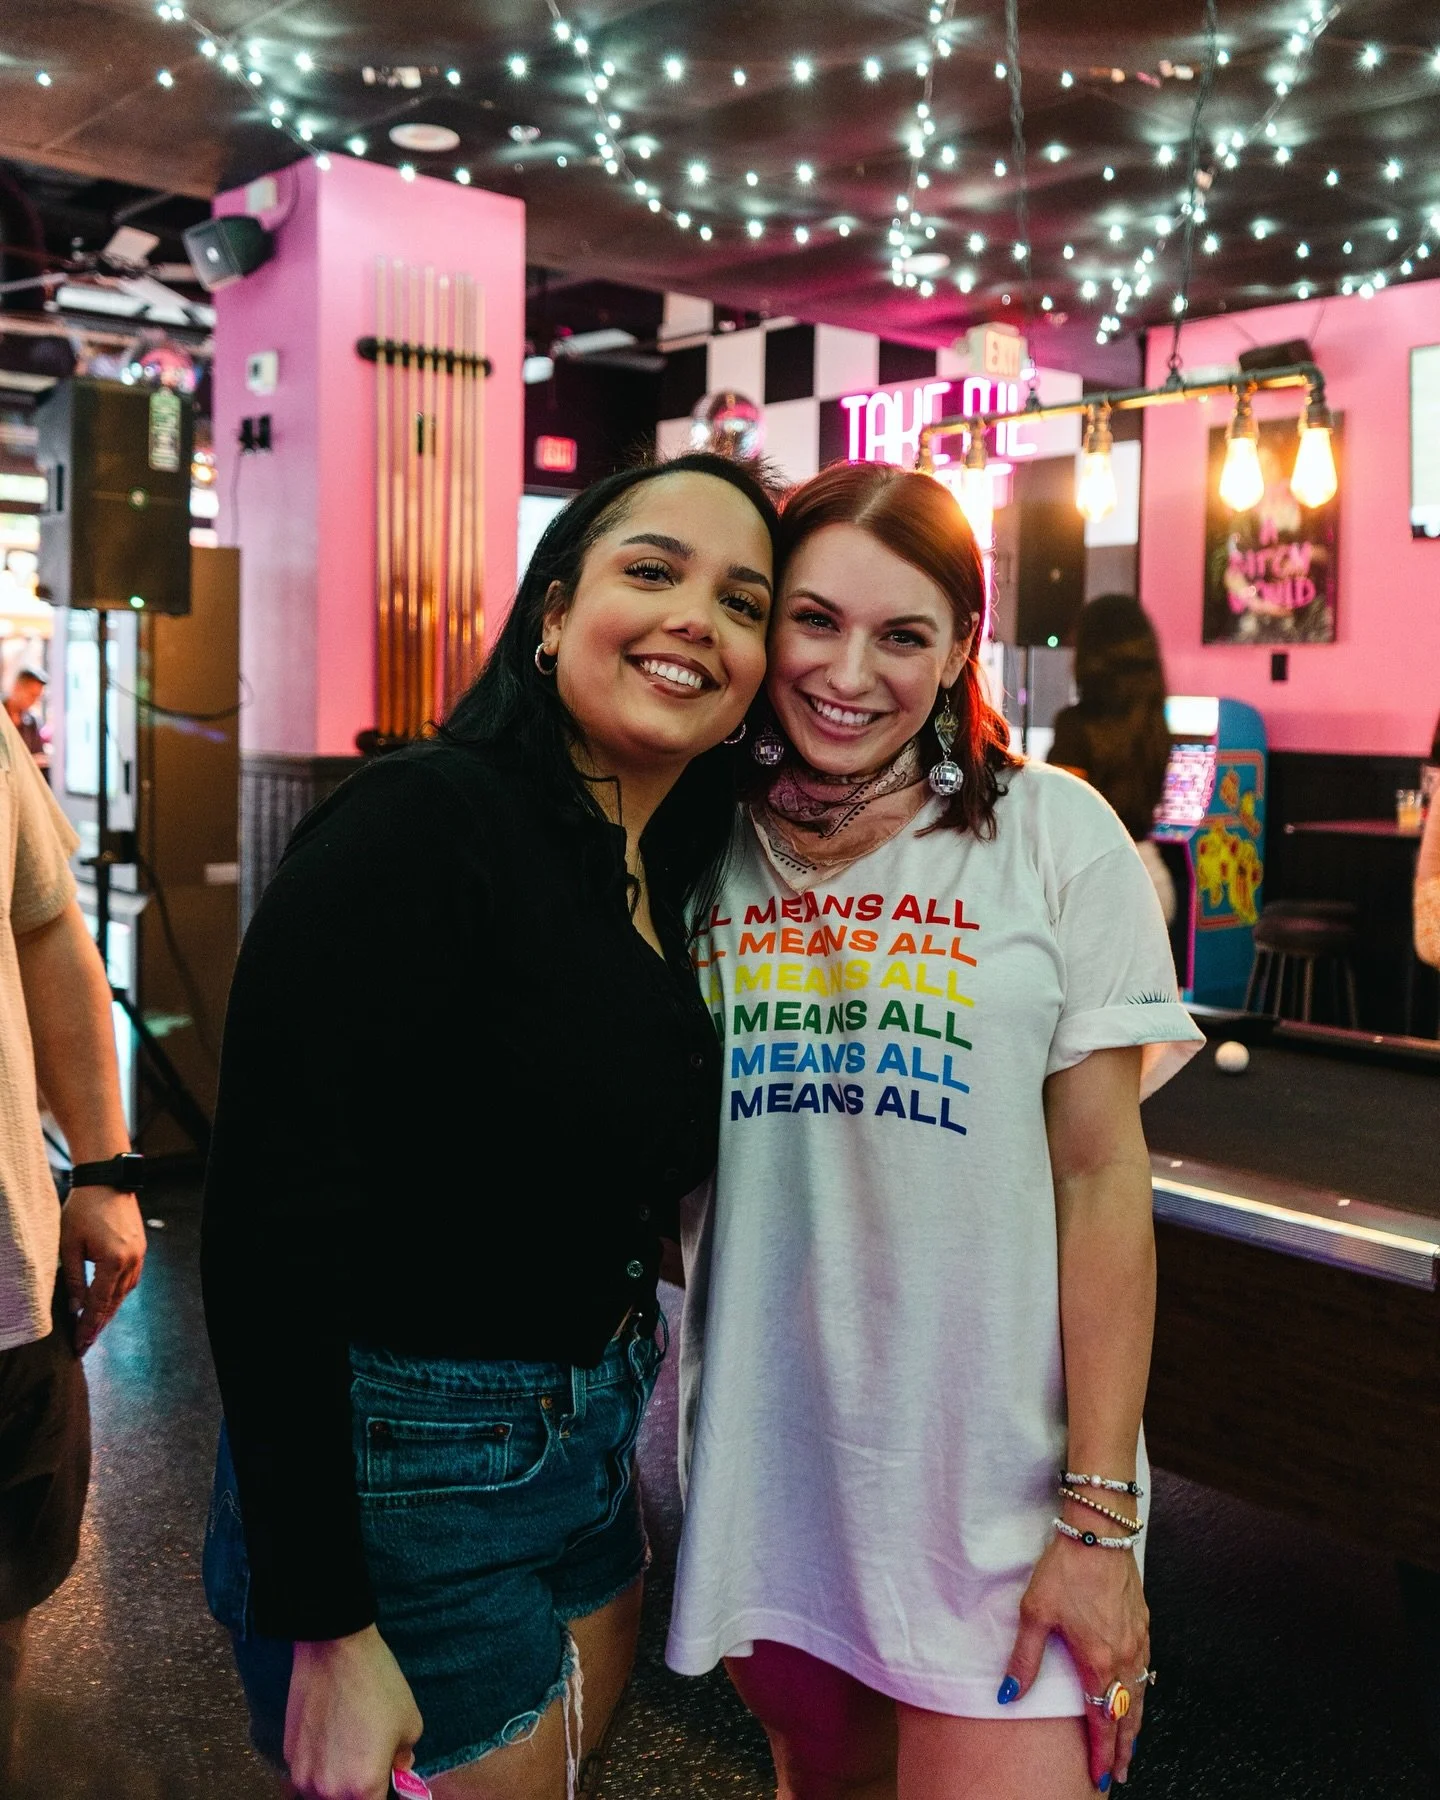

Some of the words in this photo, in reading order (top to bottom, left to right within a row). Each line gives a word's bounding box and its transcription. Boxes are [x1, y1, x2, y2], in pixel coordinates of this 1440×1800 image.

[840, 381, 951, 465] TAKE
[743, 891, 885, 925] MEANS
[891, 893, 980, 931] ALL
[738, 924, 879, 957] MEANS
[887, 932, 977, 967] ALL
[734, 959, 872, 998] MEANS
[879, 961, 976, 1009] ALL
[732, 999, 868, 1036] MEANS
[877, 999, 973, 1051] ALL
[731, 1041, 866, 1079] MEANS
[876, 1042, 970, 1095] ALL
[730, 1082, 864, 1122] MEANS
[874, 1085, 967, 1136] ALL
